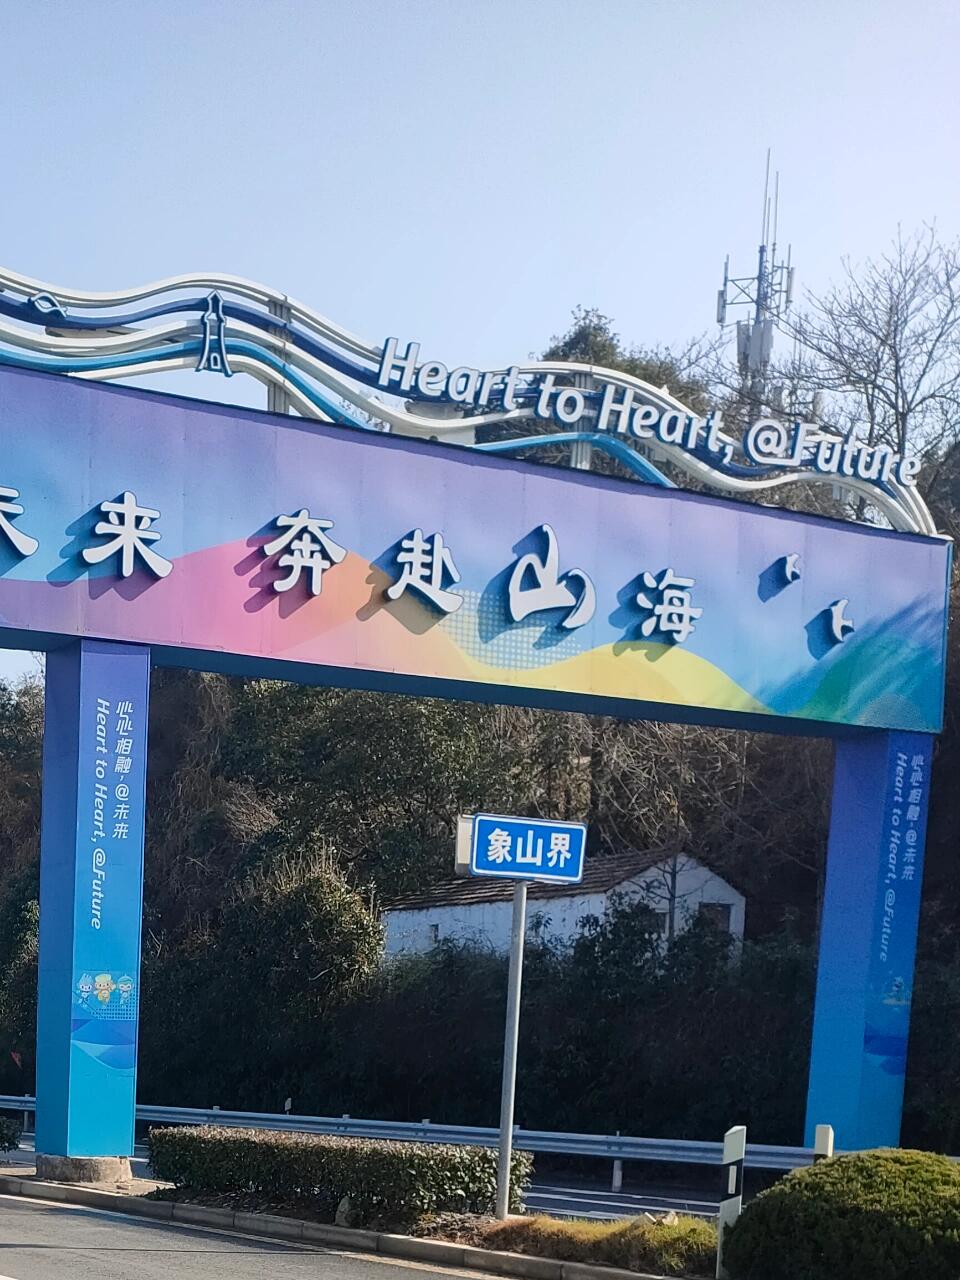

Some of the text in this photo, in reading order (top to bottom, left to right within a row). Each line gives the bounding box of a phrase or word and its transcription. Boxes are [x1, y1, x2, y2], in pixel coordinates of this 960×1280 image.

[378, 336, 922, 487] Heart to Heart, @Future
[894, 752, 908, 804] Heart
[90, 698, 111, 931] Heart to Heart, @Future
[891, 808, 902, 827] to
[487, 828, 572, 868] 象山界
[879, 888, 896, 963] @Future
